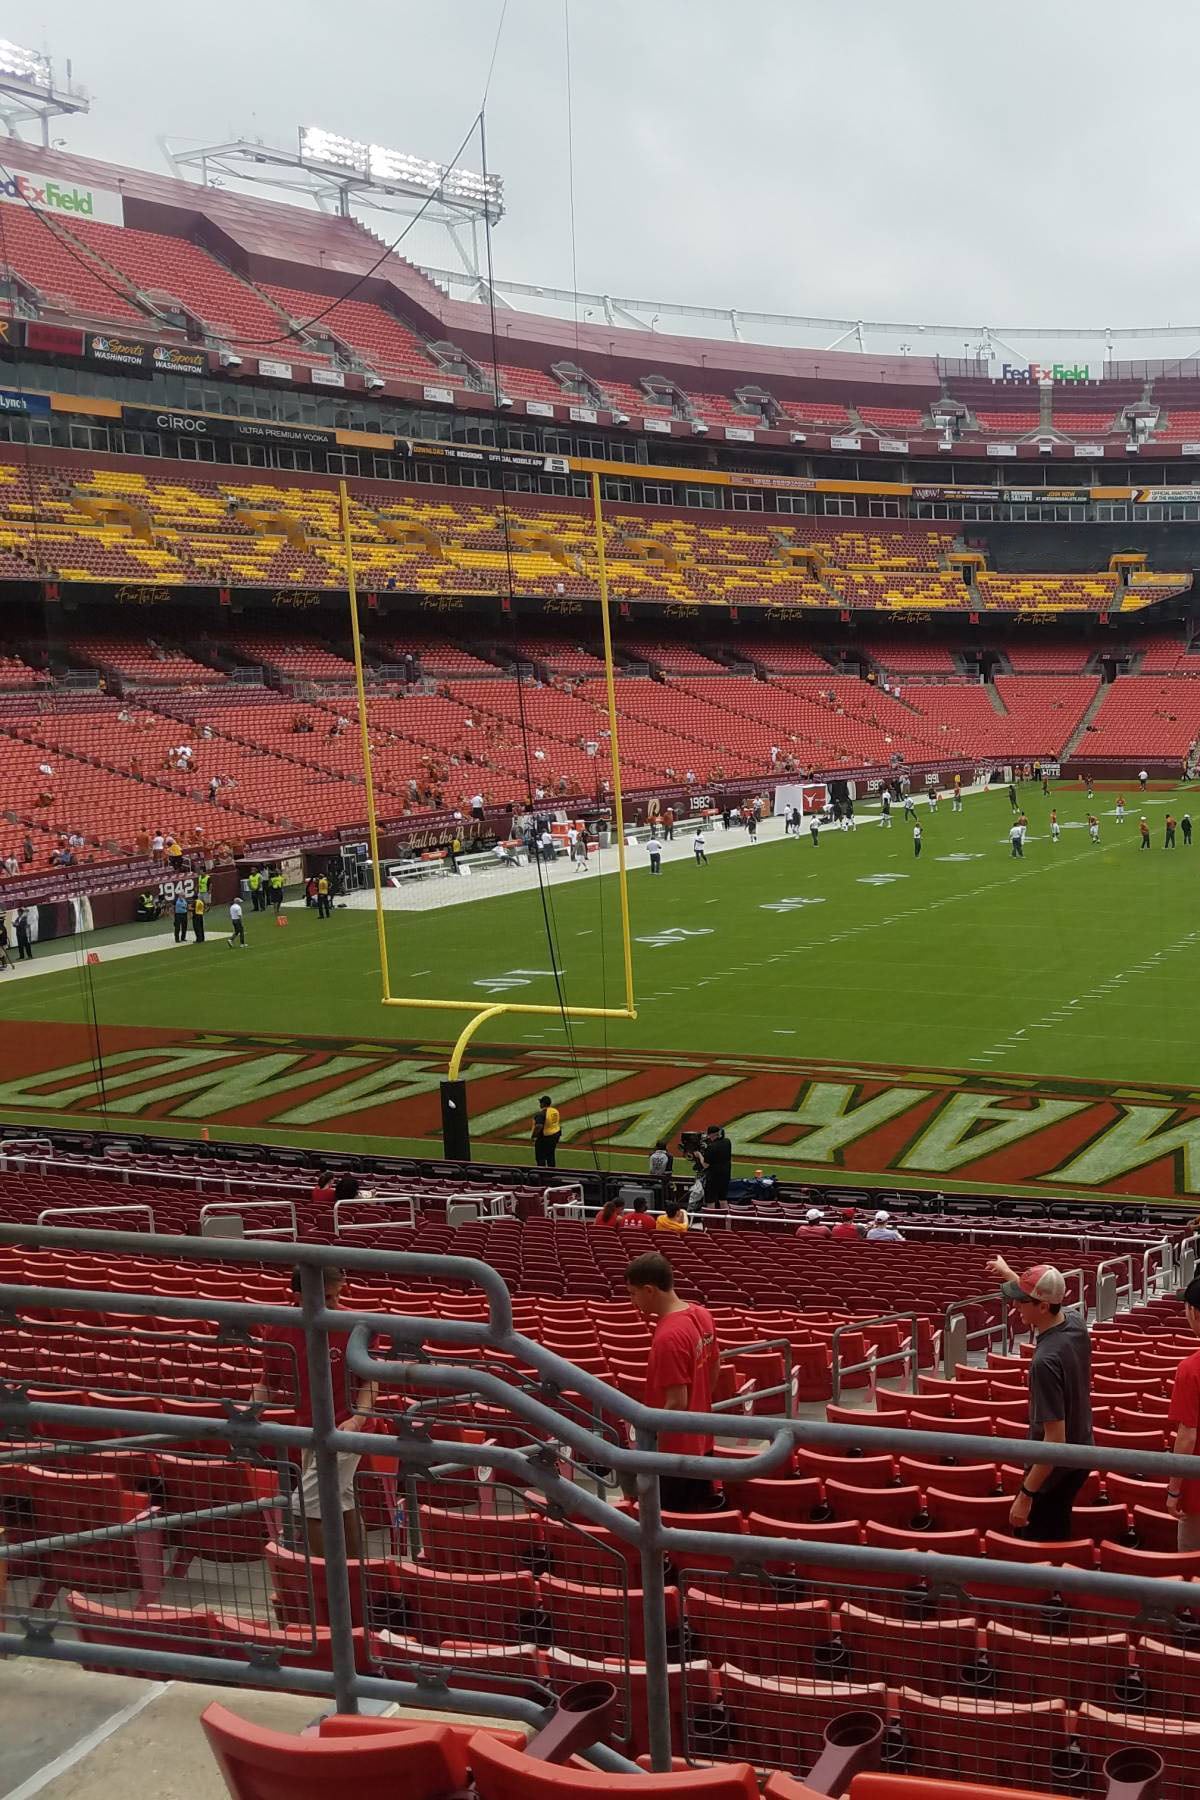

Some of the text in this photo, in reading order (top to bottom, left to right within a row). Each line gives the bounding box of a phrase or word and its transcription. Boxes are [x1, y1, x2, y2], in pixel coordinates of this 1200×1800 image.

[109, 339, 144, 356] Sports
[169, 349, 204, 365] Sports
[1002, 363, 1089, 380] FedExField
[0, 394, 27, 409] Lynch
[157, 415, 207, 432] CÎROC
[239, 427, 329, 443] ULTRA PREMIUM VODKA
[445, 450, 456, 458] THE
[925, 774, 940, 785] 1991
[690, 796, 710, 809] 1983
[408, 830, 428, 849] Hail
[428, 832, 437, 847] to
[439, 829, 453, 845] the
[159, 879, 195, 901] 1942
